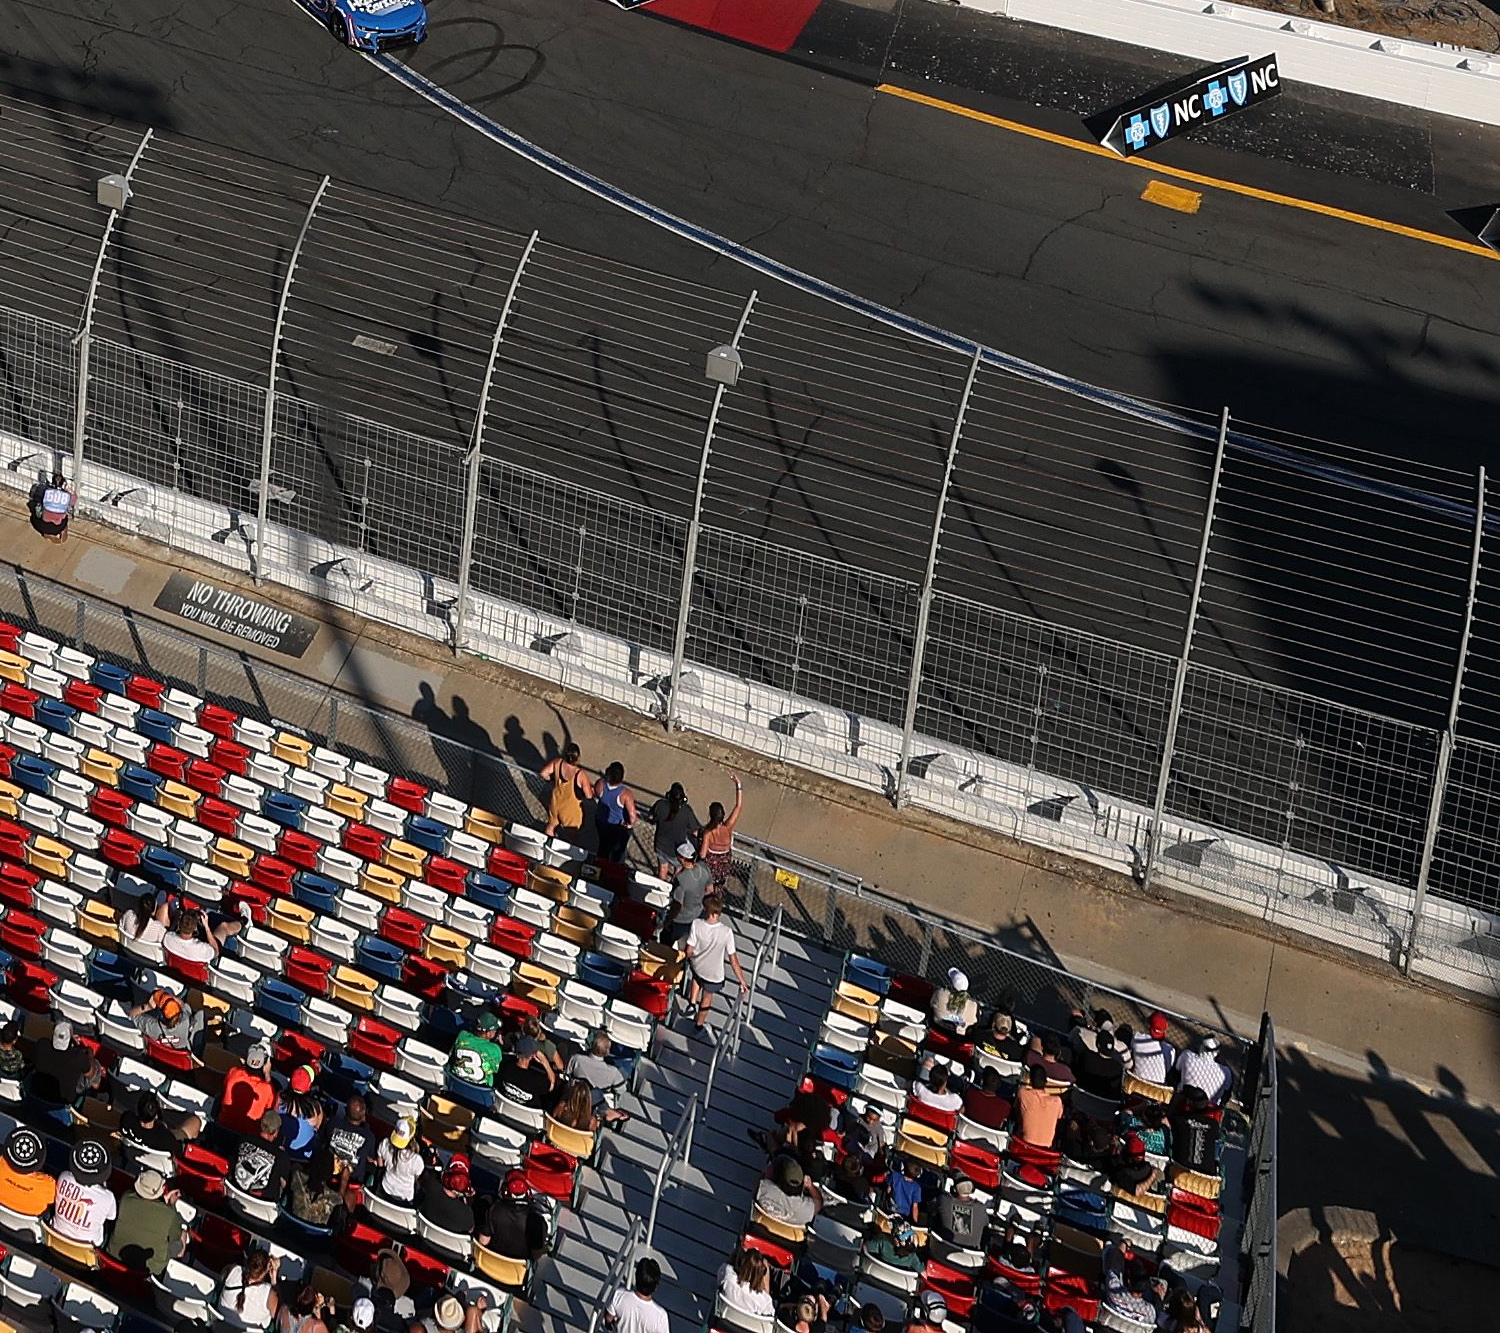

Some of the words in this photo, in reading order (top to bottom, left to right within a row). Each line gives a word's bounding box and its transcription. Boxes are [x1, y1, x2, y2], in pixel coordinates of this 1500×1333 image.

[1173, 93, 1201, 128] NC
[1250, 61, 1279, 95] NC
[180, 603, 201, 619] YOU
[199, 609, 219, 628] WILL
[221, 618, 235, 632] BE
[235, 623, 280, 648] REMOVED
[187, 581, 214, 604] NO
[212, 589, 293, 633] THROWING
[457, 1049, 485, 1082] 3
[59, 1179, 81, 1201] RED
[56, 1198, 92, 1228] BULL
